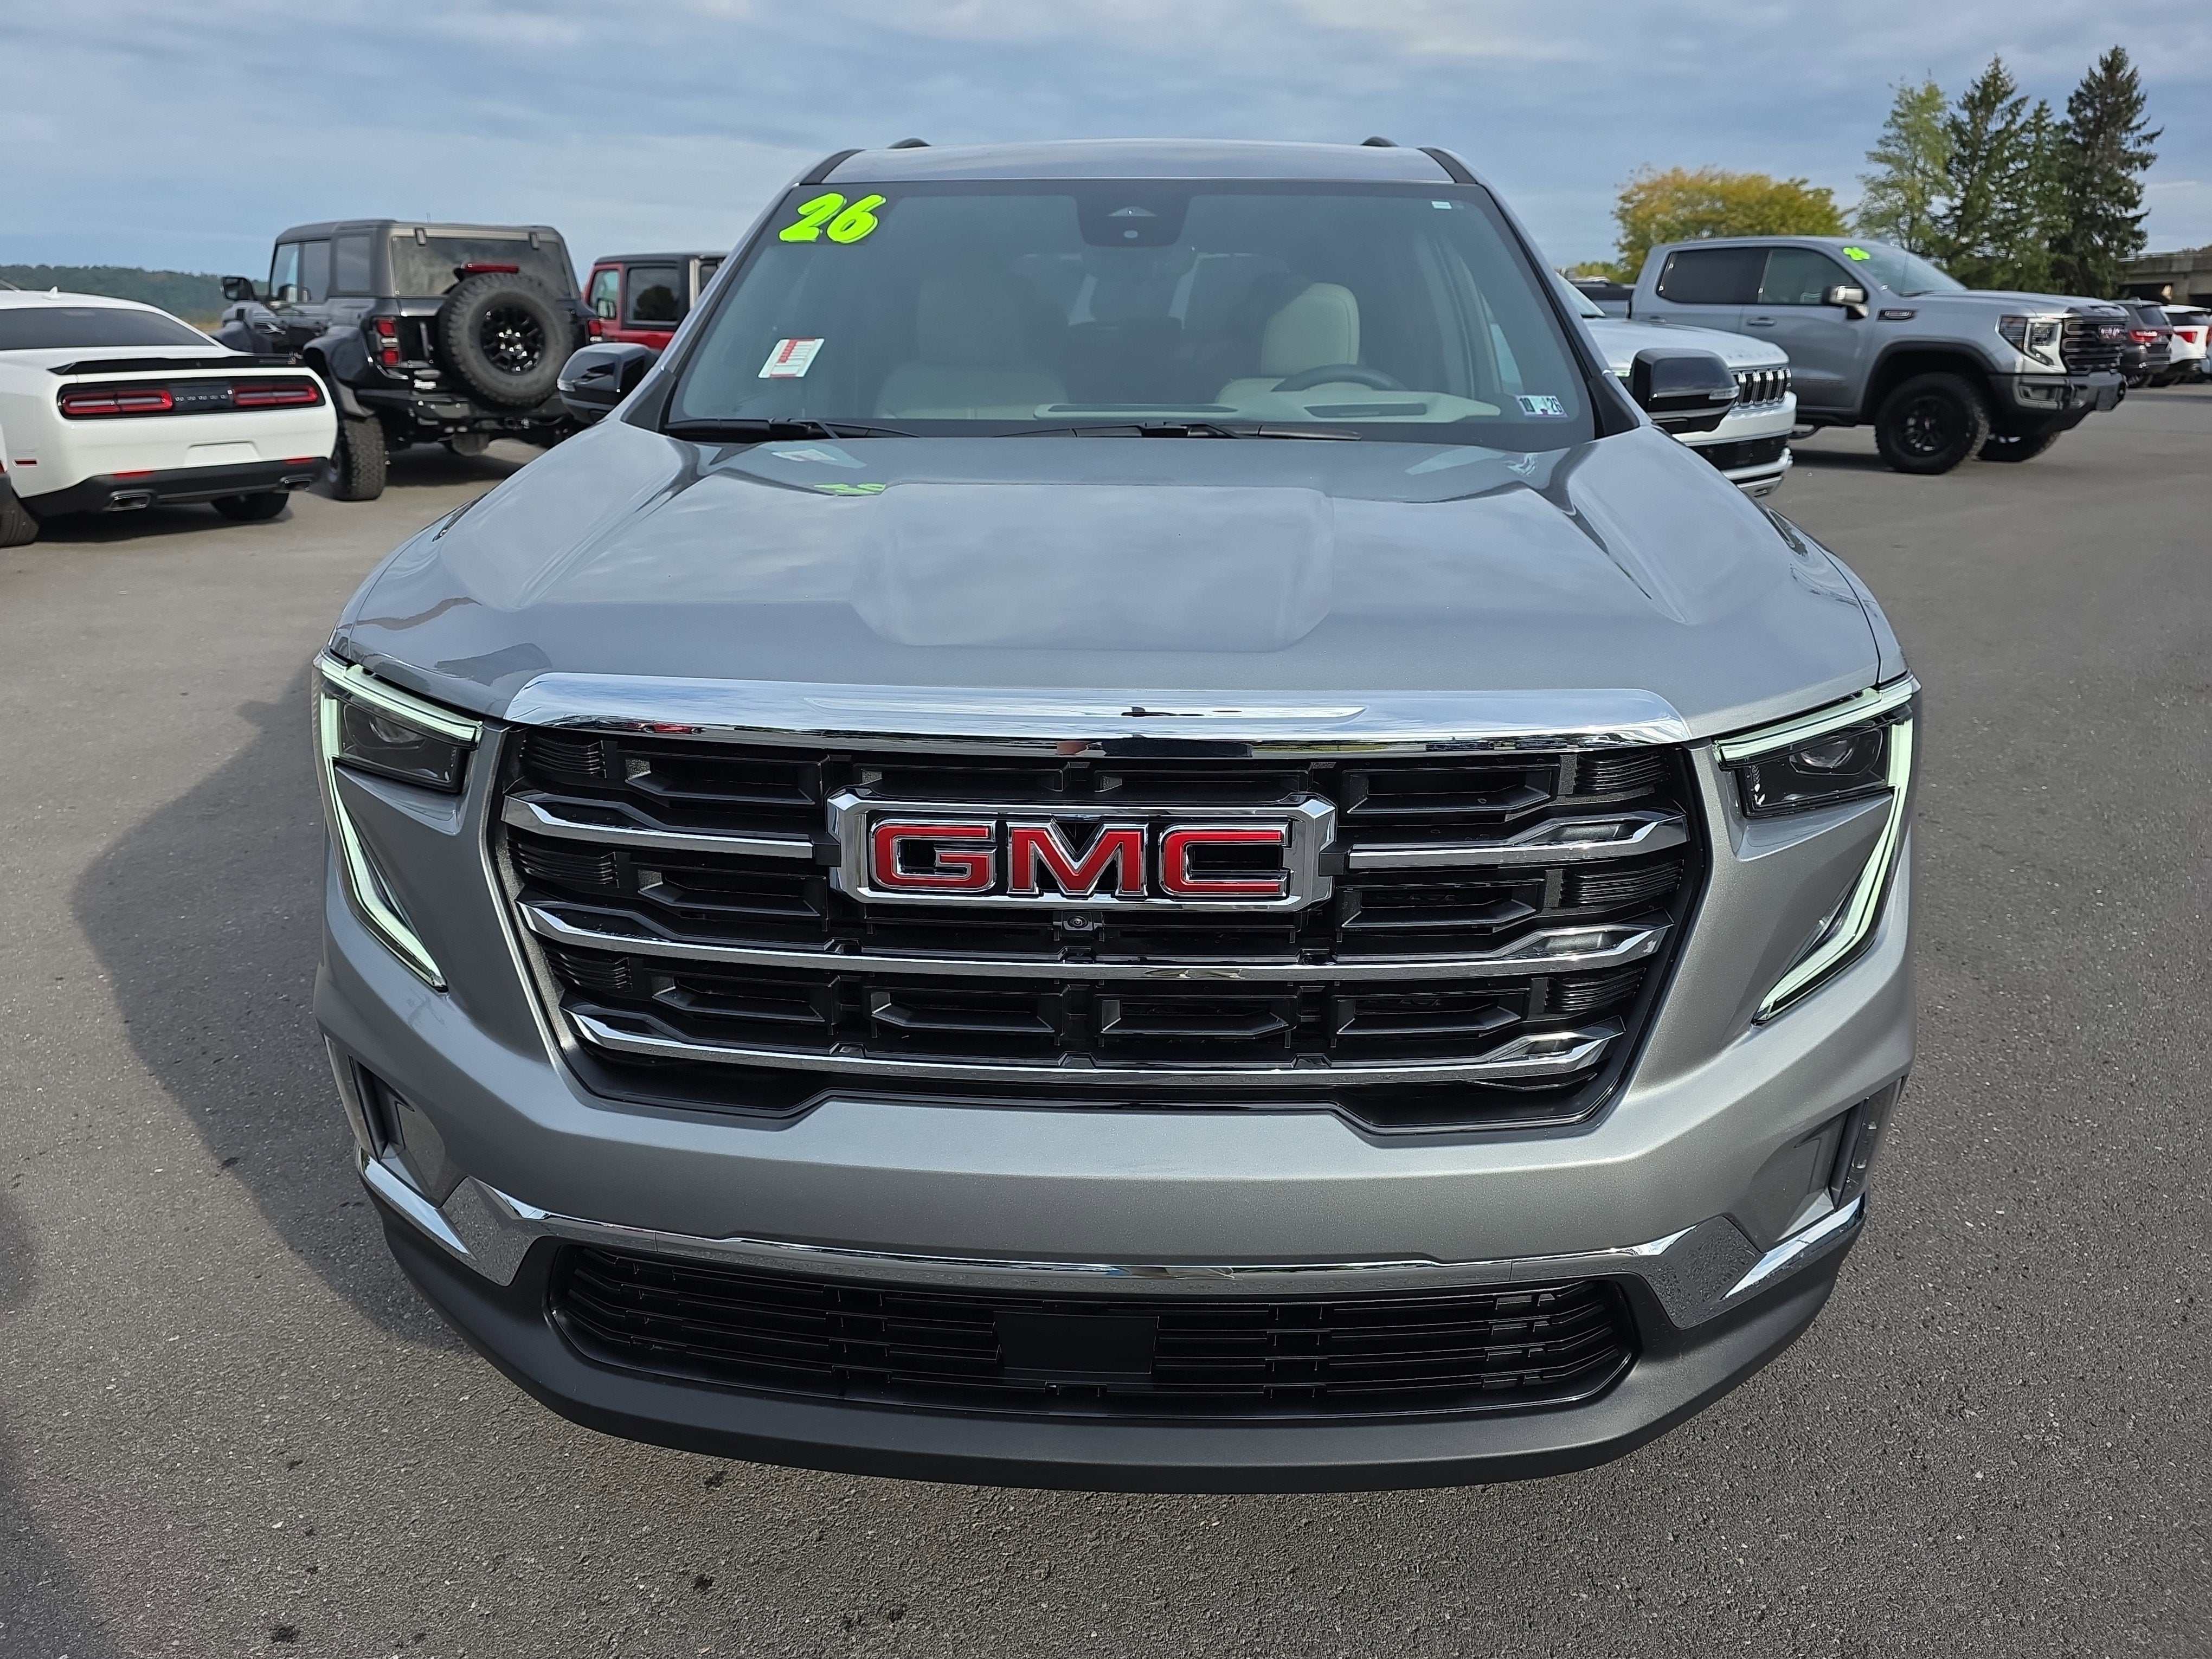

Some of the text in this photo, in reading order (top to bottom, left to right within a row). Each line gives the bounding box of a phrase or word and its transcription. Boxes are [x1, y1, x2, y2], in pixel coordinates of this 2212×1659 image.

[779, 192, 886, 244] 26
[1546, 397, 1562, 412] 26
[870, 818, 1290, 897] GMC
